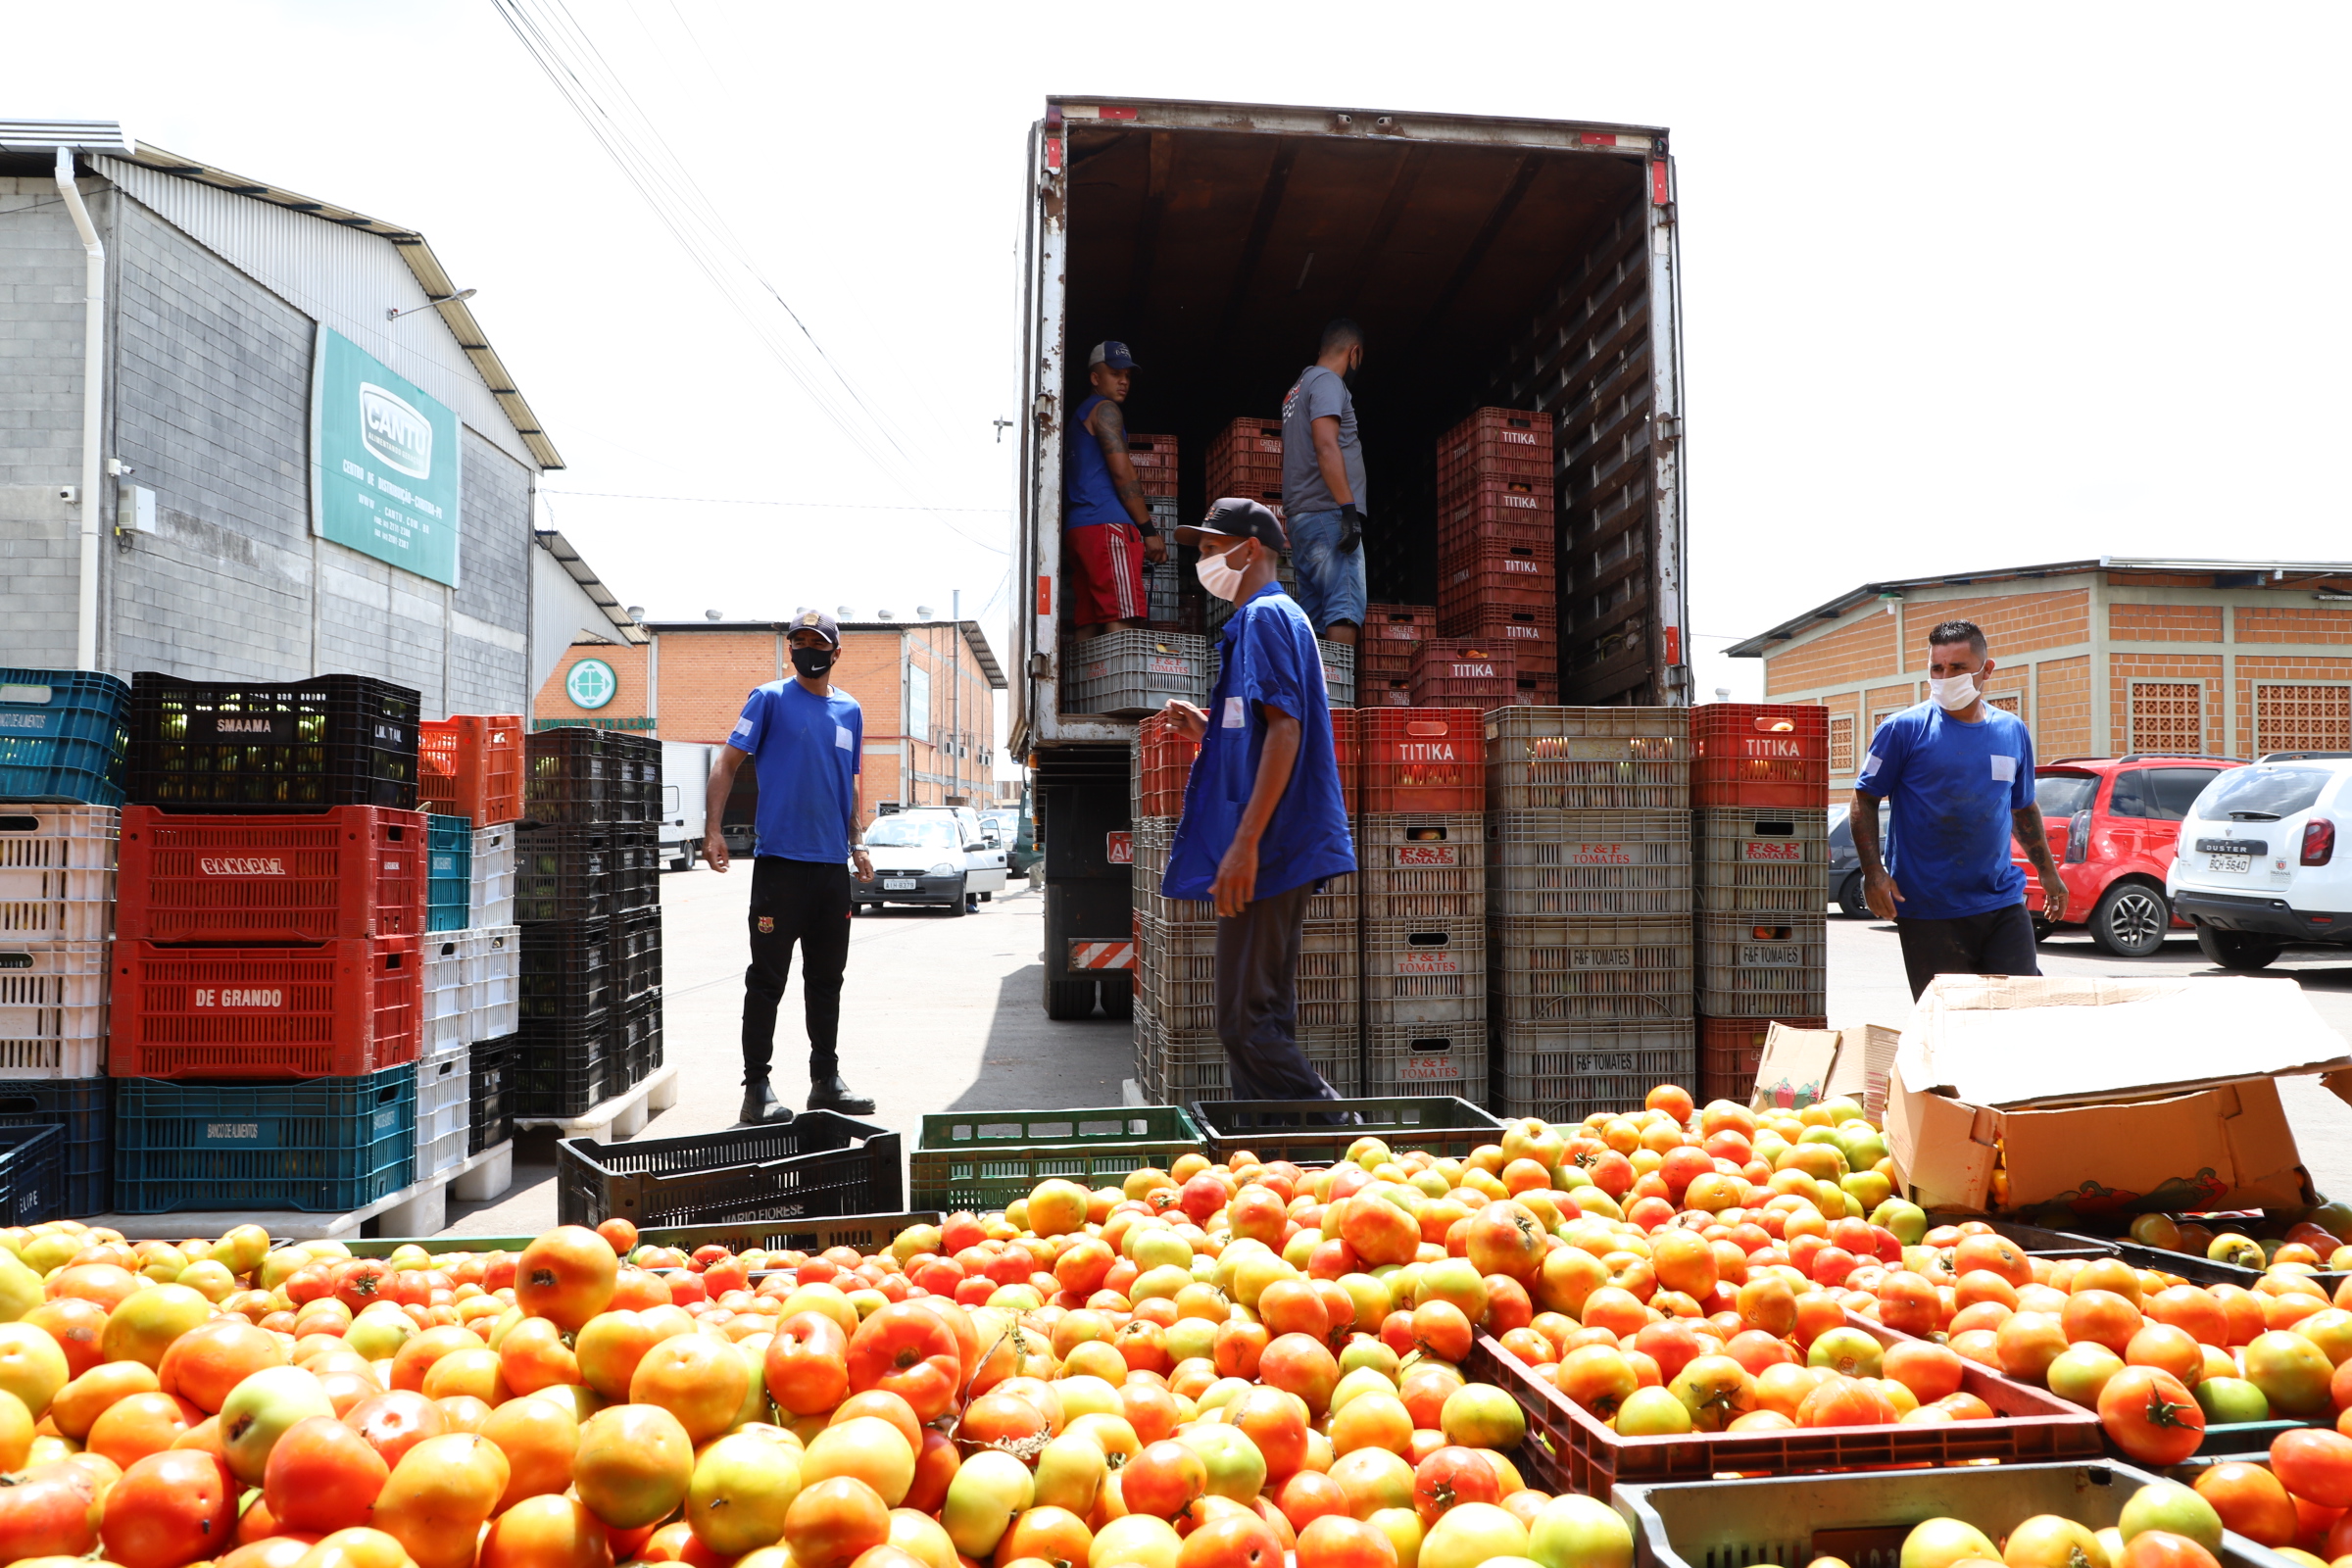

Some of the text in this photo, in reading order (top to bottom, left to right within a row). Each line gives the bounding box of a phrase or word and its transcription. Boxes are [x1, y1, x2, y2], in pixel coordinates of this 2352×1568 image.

[368, 401, 426, 456] CANTU
[1502, 431, 1536, 445] TITIKA
[1503, 496, 1537, 509] TITIKA
[1504, 561, 1538, 573] TITIKA
[1506, 626, 1539, 639] TITIKA
[1150, 663, 1189, 674] TOMATES
[1452, 664, 1494, 676] TITIKA
[217, 719, 271, 733] SMAAMA
[1399, 743, 1454, 760] TITIKA
[1745, 739, 1800, 757] TITIKA
[1581, 844, 1621, 854] F & F
[201, 858, 285, 874] BANAPAZ
[1573, 854, 1630, 864] TOMATES
[1407, 952, 1447, 961] F & F
[1574, 949, 1630, 965] F&F TOMATES
[1743, 946, 1798, 963] F&F TOMATES
[1398, 962, 1456, 972] TOMATES
[196, 989, 282, 1007] DE GRANDO
[1409, 1057, 1449, 1067] F & F
[1577, 1054, 1632, 1070] F&F TOMATES
[1400, 1067, 1458, 1079] TOMATES
[207, 1123, 224, 1139] BANCO
[233, 1123, 258, 1139] ALIMENTOS
[759, 1204, 805, 1220] FIORESE
